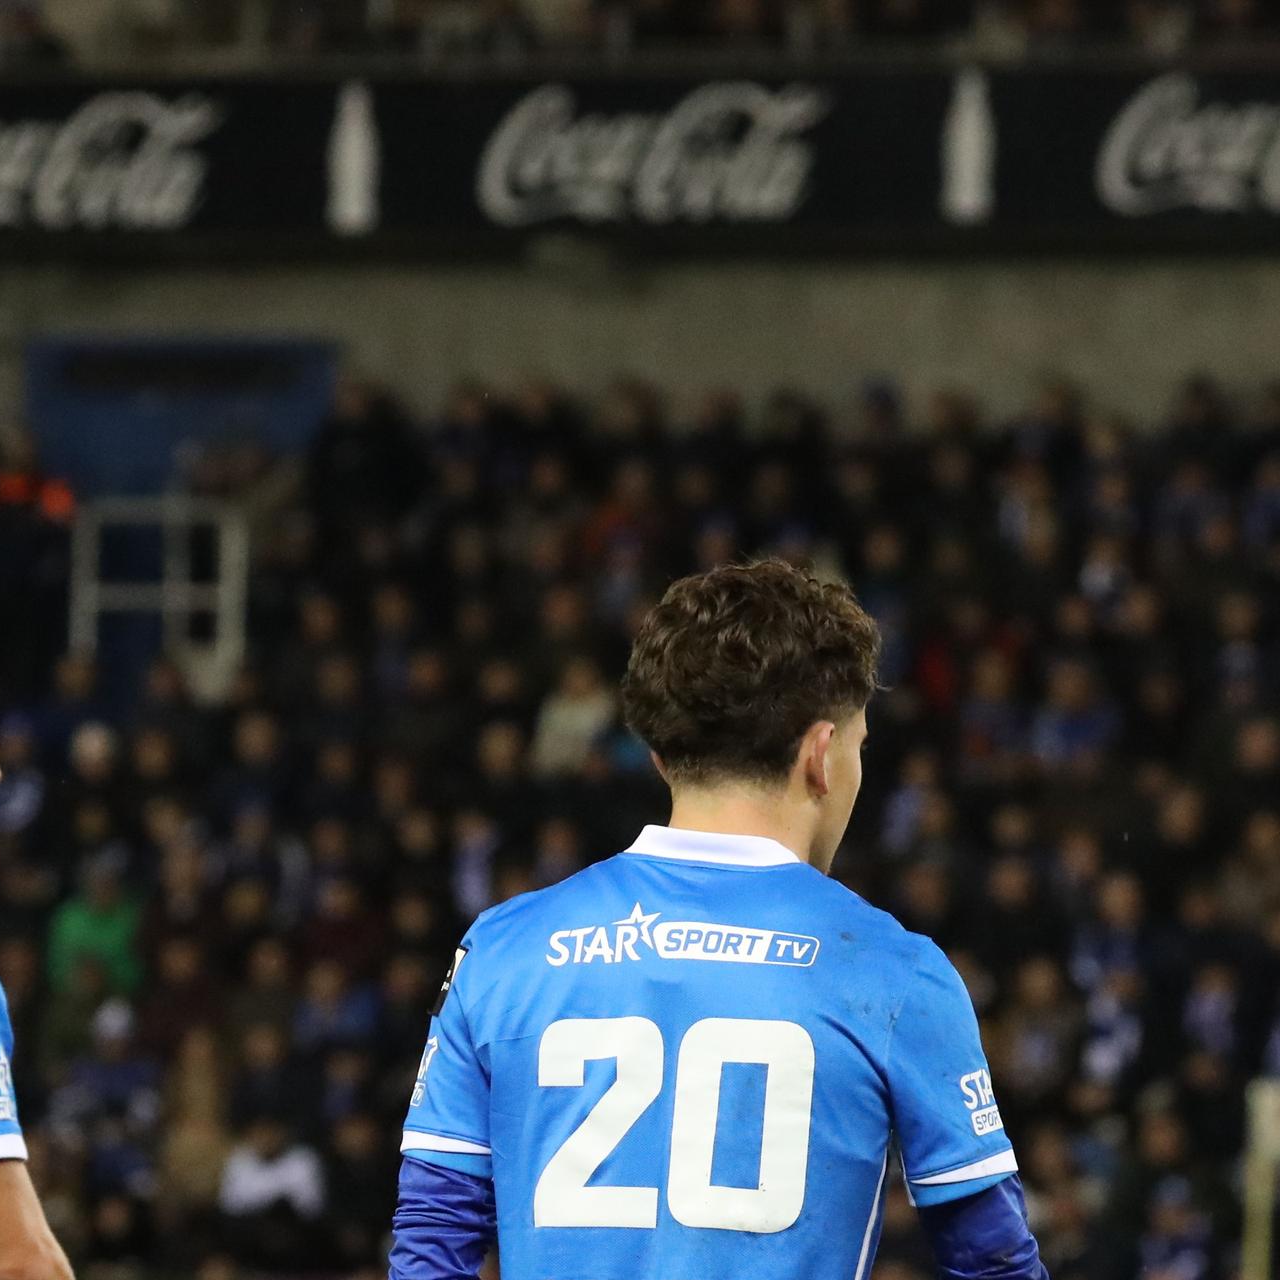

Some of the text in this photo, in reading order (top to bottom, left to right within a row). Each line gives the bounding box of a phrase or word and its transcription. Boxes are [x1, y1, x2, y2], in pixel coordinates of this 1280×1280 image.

[546, 924, 812, 967] STAR SPORT TV
[960, 1068, 995, 1111] STA
[534, 1016, 816, 1234] 20
[975, 1110, 1000, 1131] SPOR
